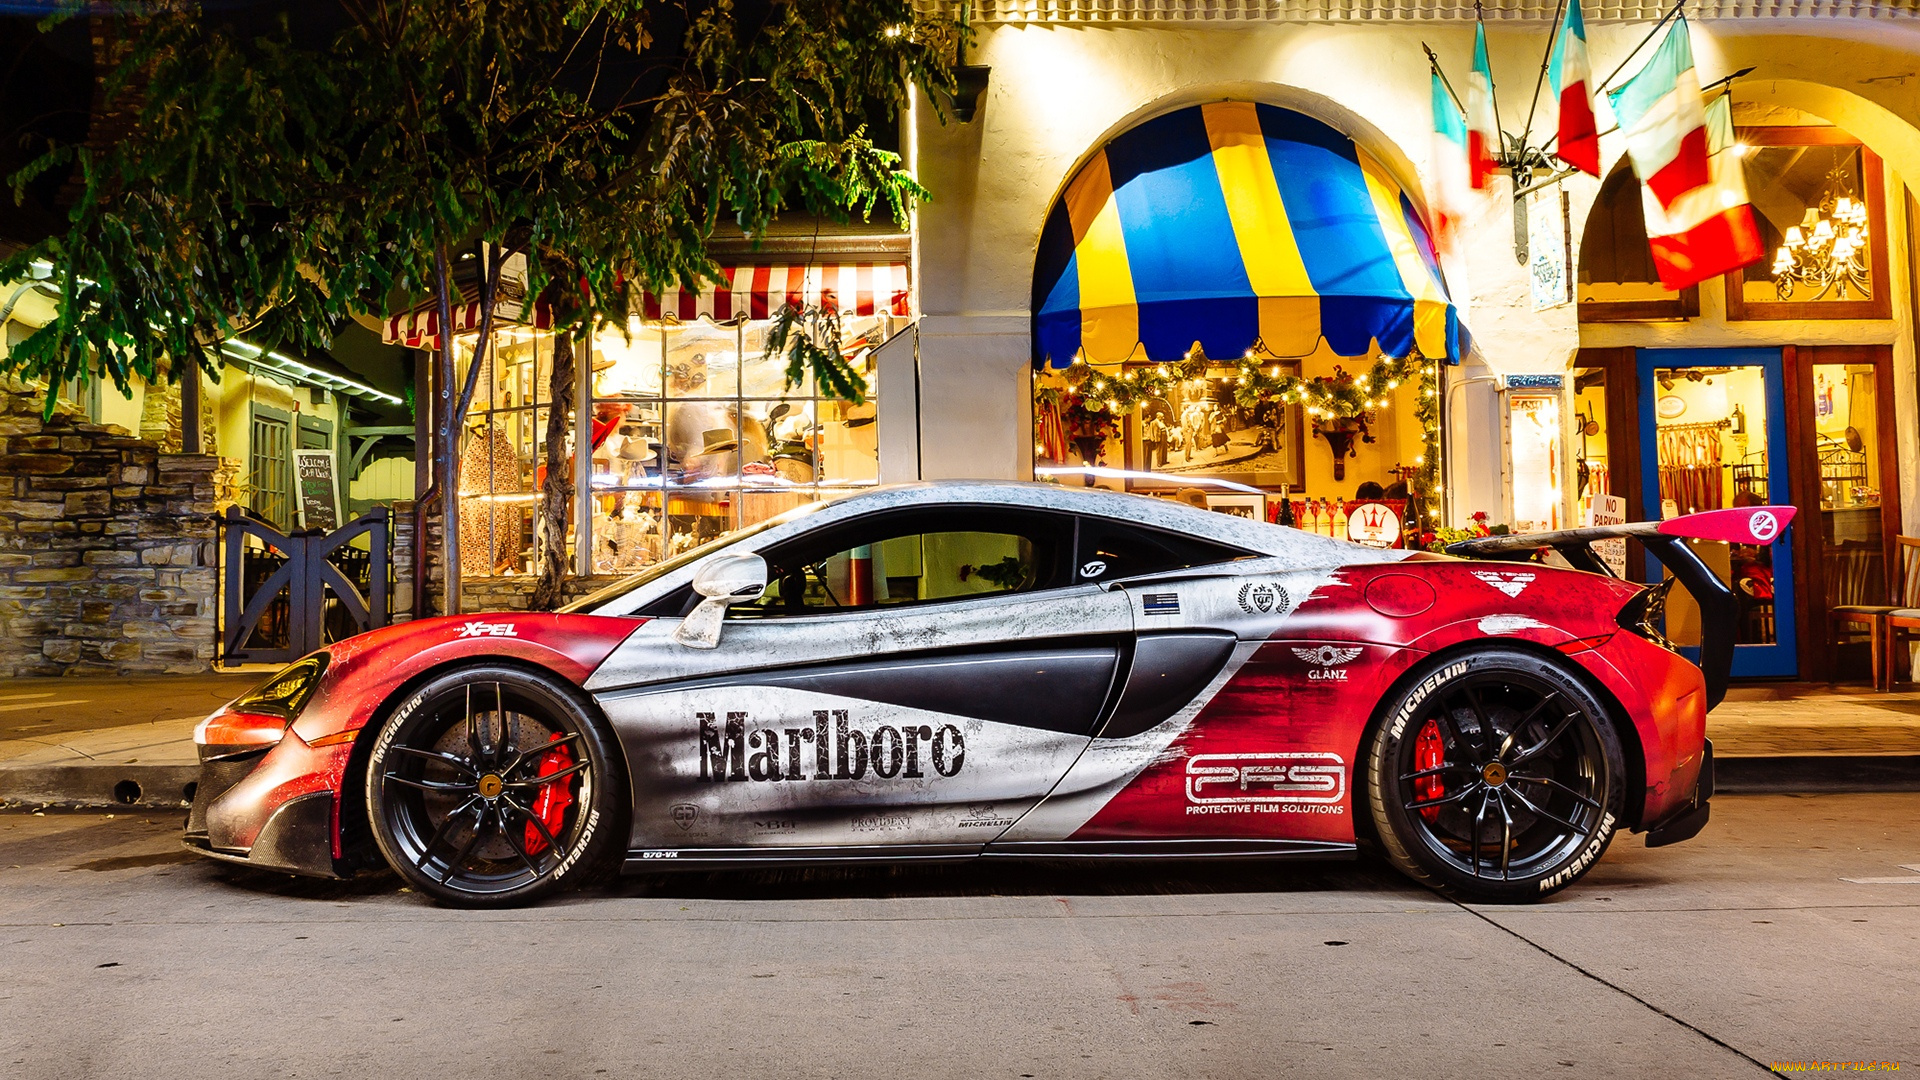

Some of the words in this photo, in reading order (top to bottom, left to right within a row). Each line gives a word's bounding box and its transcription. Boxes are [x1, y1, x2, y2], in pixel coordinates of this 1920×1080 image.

[1605, 498, 1617, 513] NO
[459, 621, 518, 637] XPEL
[1307, 667, 1348, 680] GLÄNZ
[1391, 660, 1468, 740] MICHELIN
[373, 694, 422, 764] MICHELIN
[696, 709, 966, 782] Marlboro
[958, 819, 1012, 828] MICHELIN
[1186, 804, 1250, 815] PROTECTIVE
[1254, 804, 1279, 813] FILM
[1281, 804, 1344, 815] SOLUTIONS
[553, 809, 600, 881] MICHELIN
[1539, 811, 1616, 892] MICHELIN
